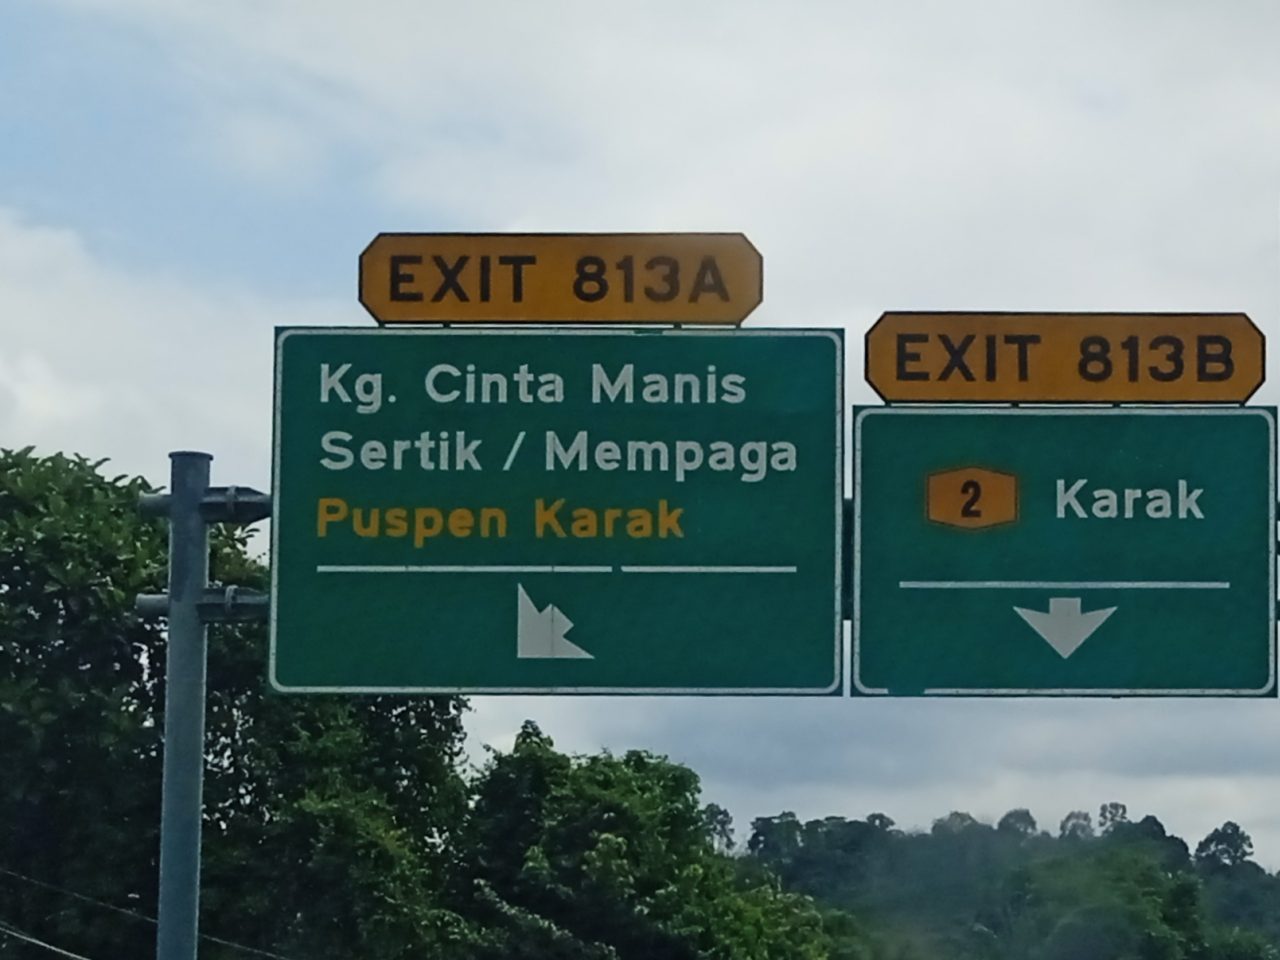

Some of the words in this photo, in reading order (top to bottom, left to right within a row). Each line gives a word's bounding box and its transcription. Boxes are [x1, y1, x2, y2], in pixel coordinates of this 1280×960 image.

[390, 255, 536, 303] EXIT
[572, 255, 729, 303] 813A
[896, 334, 1041, 382] EXIT
[1078, 335, 1234, 383] 813B
[321, 364, 396, 413] Kg.
[425, 364, 564, 403] Cinta
[592, 364, 745, 403] Manis
[320, 431, 481, 470] Sertik
[503, 432, 525, 470] /
[546, 431, 796, 482] Mempaga
[318, 498, 506, 548] Puspen
[536, 499, 683, 538] Karak
[961, 480, 981, 517] 2
[1057, 479, 1204, 518] Karak
